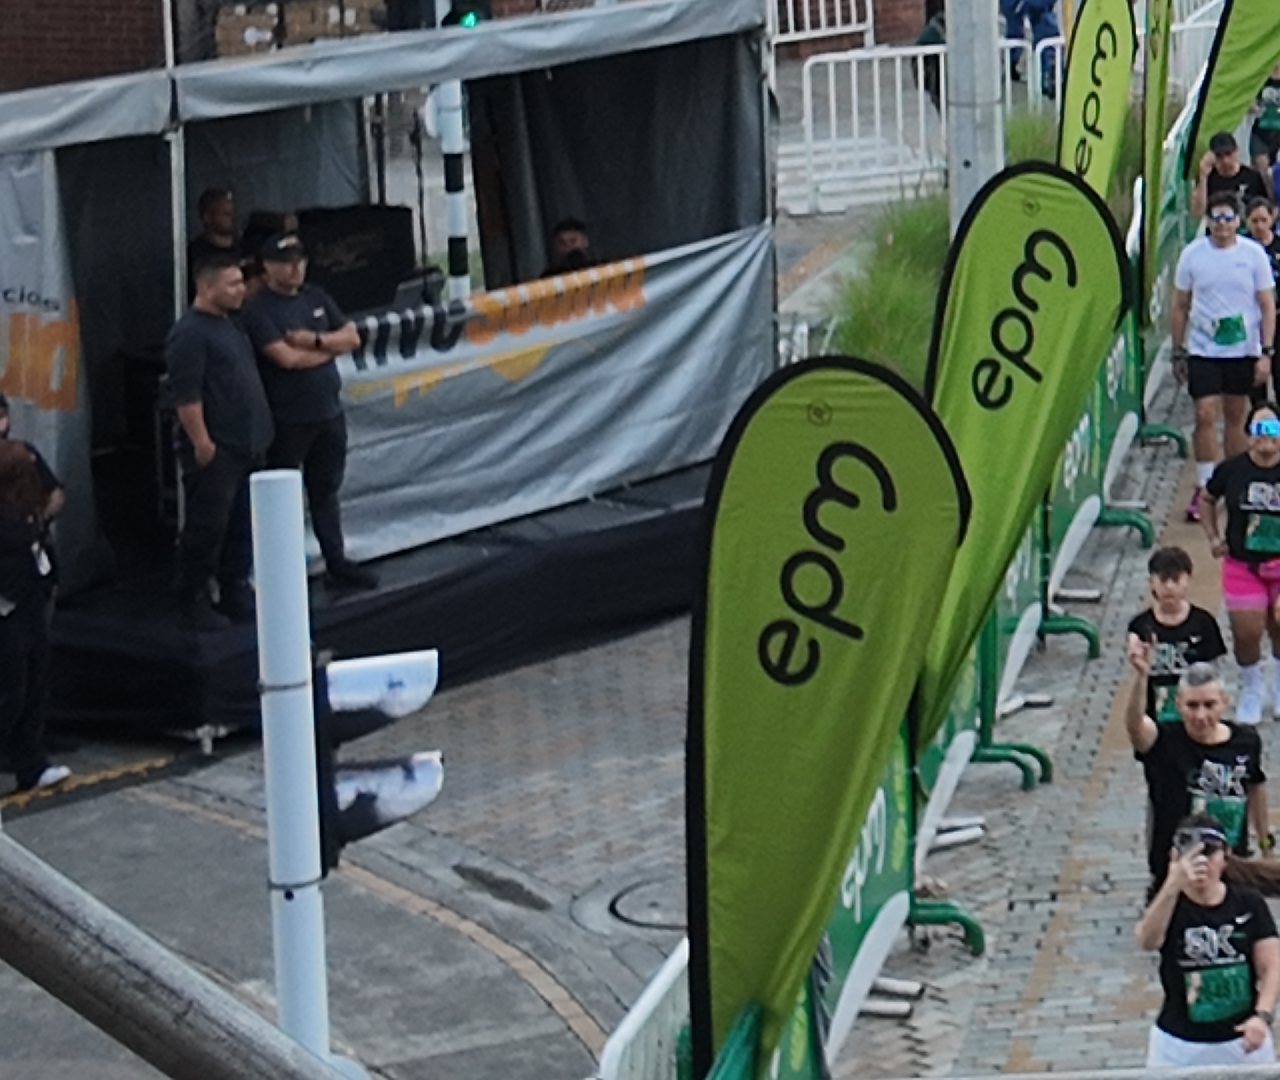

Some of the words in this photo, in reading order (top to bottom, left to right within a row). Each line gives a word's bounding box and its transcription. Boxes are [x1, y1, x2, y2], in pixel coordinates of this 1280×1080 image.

[1075, 21, 1117, 176] epm
[972, 228, 1078, 411] epm
[756, 441, 897, 685] epm
[841, 786, 886, 924] epm
[1184, 924, 1238, 961] 5K
